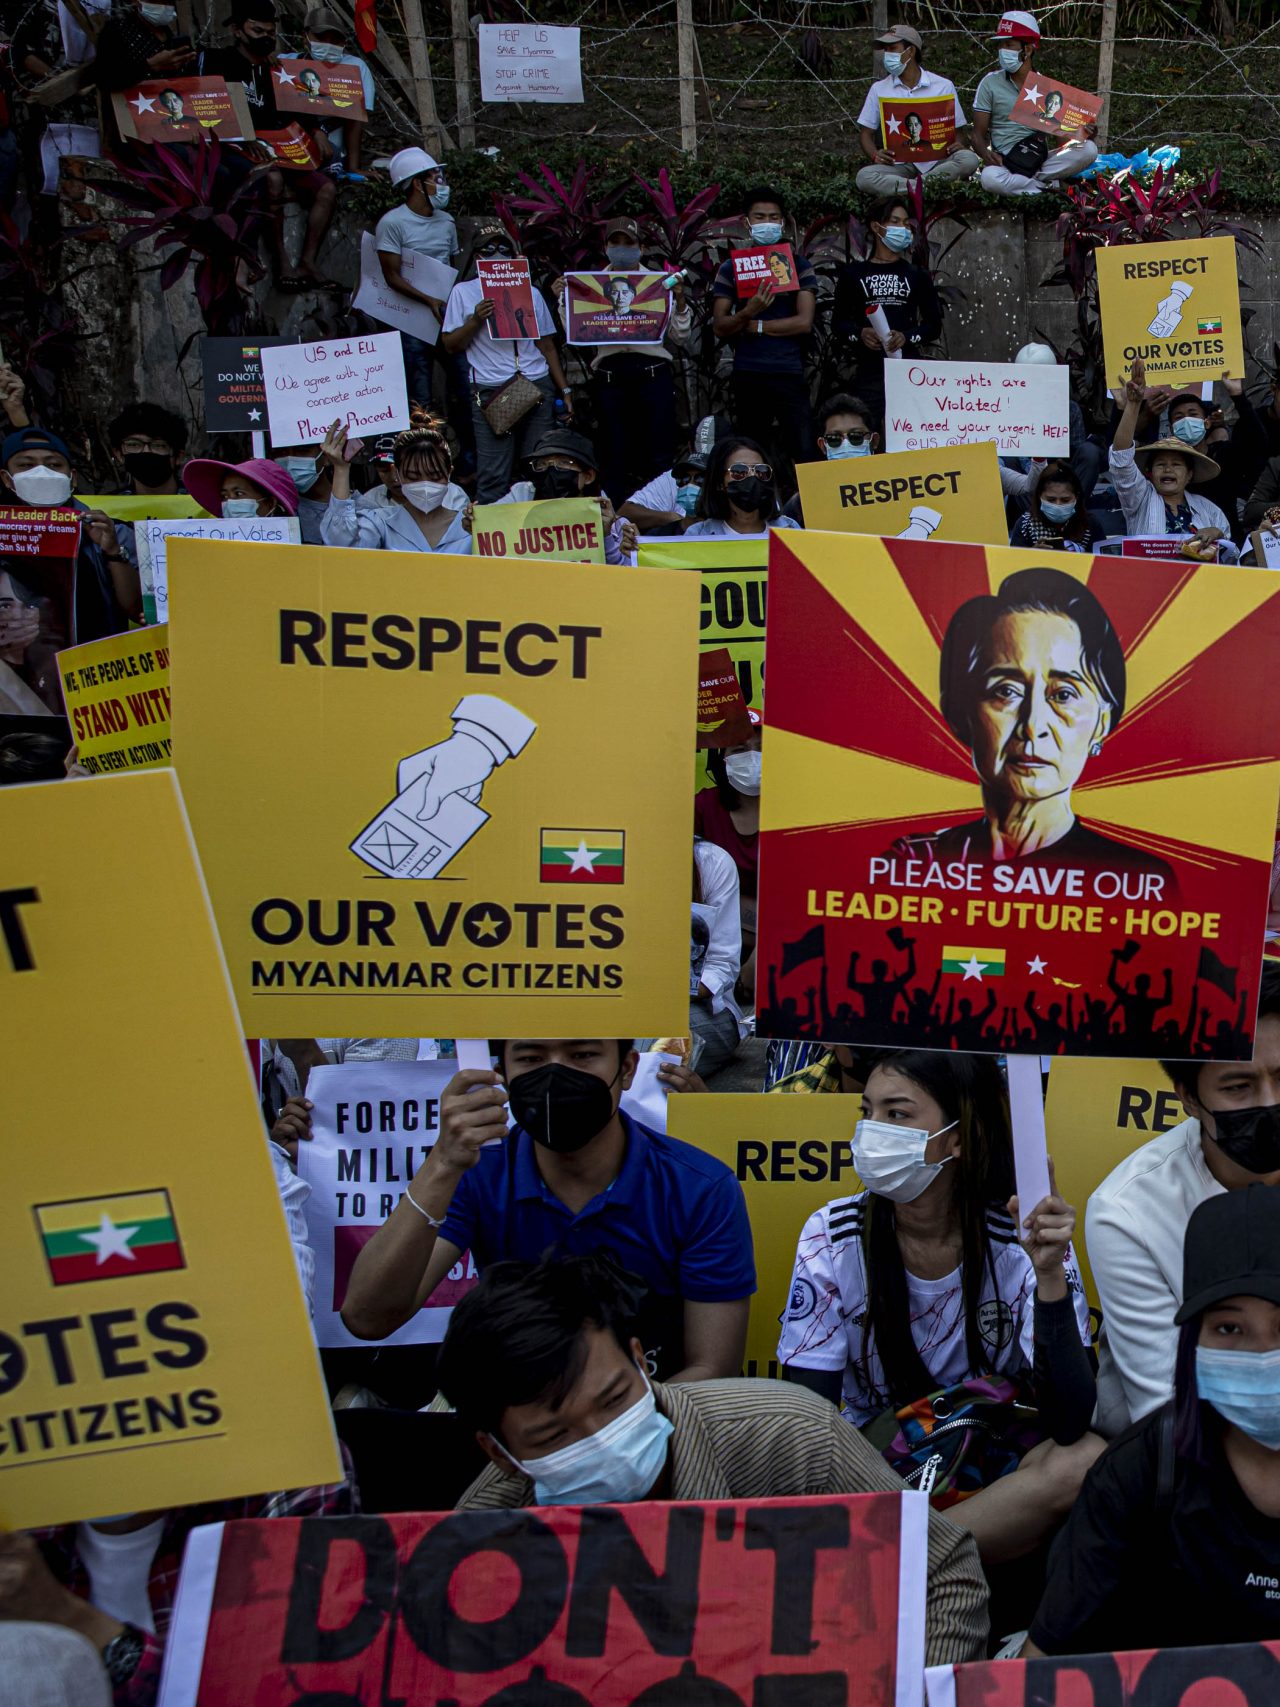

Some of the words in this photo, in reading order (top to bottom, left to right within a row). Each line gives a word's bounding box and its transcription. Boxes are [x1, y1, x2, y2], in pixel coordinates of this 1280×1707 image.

[535, 30, 548, 42] US
[496, 70, 516, 78] STOP
[522, 69, 550, 78] CRIME
[734, 255, 767, 272] FREE
[1124, 257, 1208, 280] RESPECT
[866, 274, 898, 284] POWER
[870, 280, 906, 290] MONEY
[872, 287, 910, 297] RESPECT
[304, 346, 326, 363] US
[334, 344, 353, 358] and
[1123, 345, 1161, 361] OUR
[1166, 339, 1224, 357] VOTES
[244, 364, 260, 372] WE
[1180, 357, 1225, 368] CITIZENS
[218, 373, 233, 382] DO
[236, 373, 256, 382] NOT
[275, 374, 300, 391] We
[304, 376, 332, 393] agree
[336, 365, 358, 380] with
[364, 364, 384, 382] your
[908, 366, 946, 387] Our
[956, 373, 992, 394] rights
[1002, 378, 1026, 388] are
[306, 394, 350, 408] concrete
[892, 416, 913, 432] We
[920, 418, 950, 432] need
[958, 424, 992, 438] your
[998, 423, 1036, 440] urgent
[1043, 424, 1070, 438] HELP
[839, 472, 962, 508] RESPECT
[11, 508, 48, 522] Leader
[50, 510, 78, 522] Back
[476, 530, 507, 557] NO
[514, 522, 600, 556] JUSTICE
[279, 608, 603, 680] RESPECT
[74, 698, 130, 742] STAND
[868, 857, 983, 892] PLEASE
[992, 864, 1084, 898] SAVE
[1094, 869, 1165, 902] OUR
[251, 898, 396, 947] OUR
[418, 902, 626, 950] VOTES
[806, 889, 942, 925] LEADER
[966, 902, 1102, 934] FUTURE
[1124, 909, 1221, 940] HOPE
[252, 960, 452, 989] MYANMAR
[462, 962, 624, 989] CITIZENS
[736, 1140, 853, 1182] RESP
[0, 1389, 222, 1454] ITIZENS
[281, 1504, 852, 1665] DON'T
[1244, 1572, 1280, 1588] Anne
